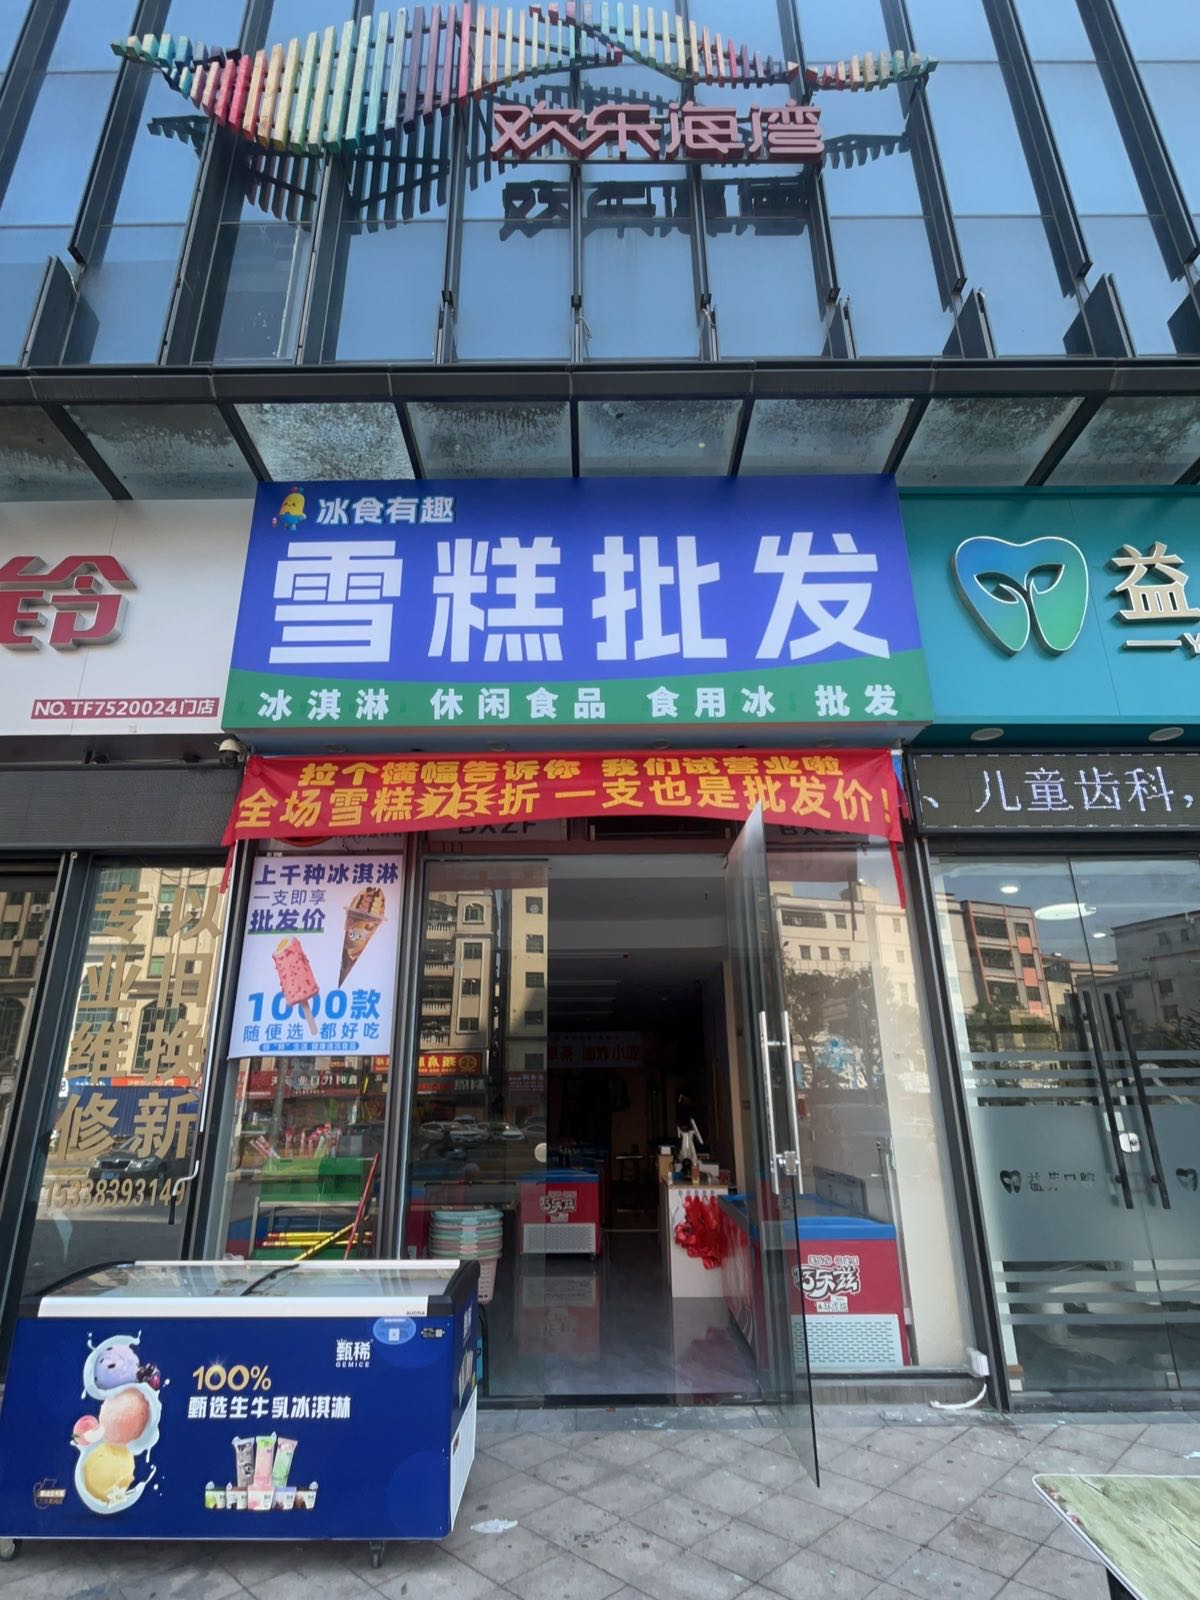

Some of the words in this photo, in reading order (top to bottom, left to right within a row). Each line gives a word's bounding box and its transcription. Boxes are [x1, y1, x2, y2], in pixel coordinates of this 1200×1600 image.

[490, 99, 824, 160] 欢乐海湾
[316, 496, 455, 525] 冰食有趣
[1112, 541, 1200, 620] 益
[269, 532, 890, 664] 雪糕批发
[258, 688, 389, 721] 冰淇淋
[429, 686, 606, 721] 休闲食品
[646, 684, 776, 719] 食用冰
[815, 683, 899, 718] 批发
[298, 758, 581, 787] 拉个横幅告诉你
[601, 755, 843, 778] 我们试营业啦
[254, 863, 399, 885] 上千种冰淇淋
[253, 889, 326, 906] 一支即享
[250, 908, 326, 932] 批发价
[243, 1023, 304, 1042] 随便选
[320, 1022, 380, 1041] 都好吃
[192, 1364, 272, 1391] 100%
[187, 1395, 351, 1419] 甄选生牛乳冰淇淋
